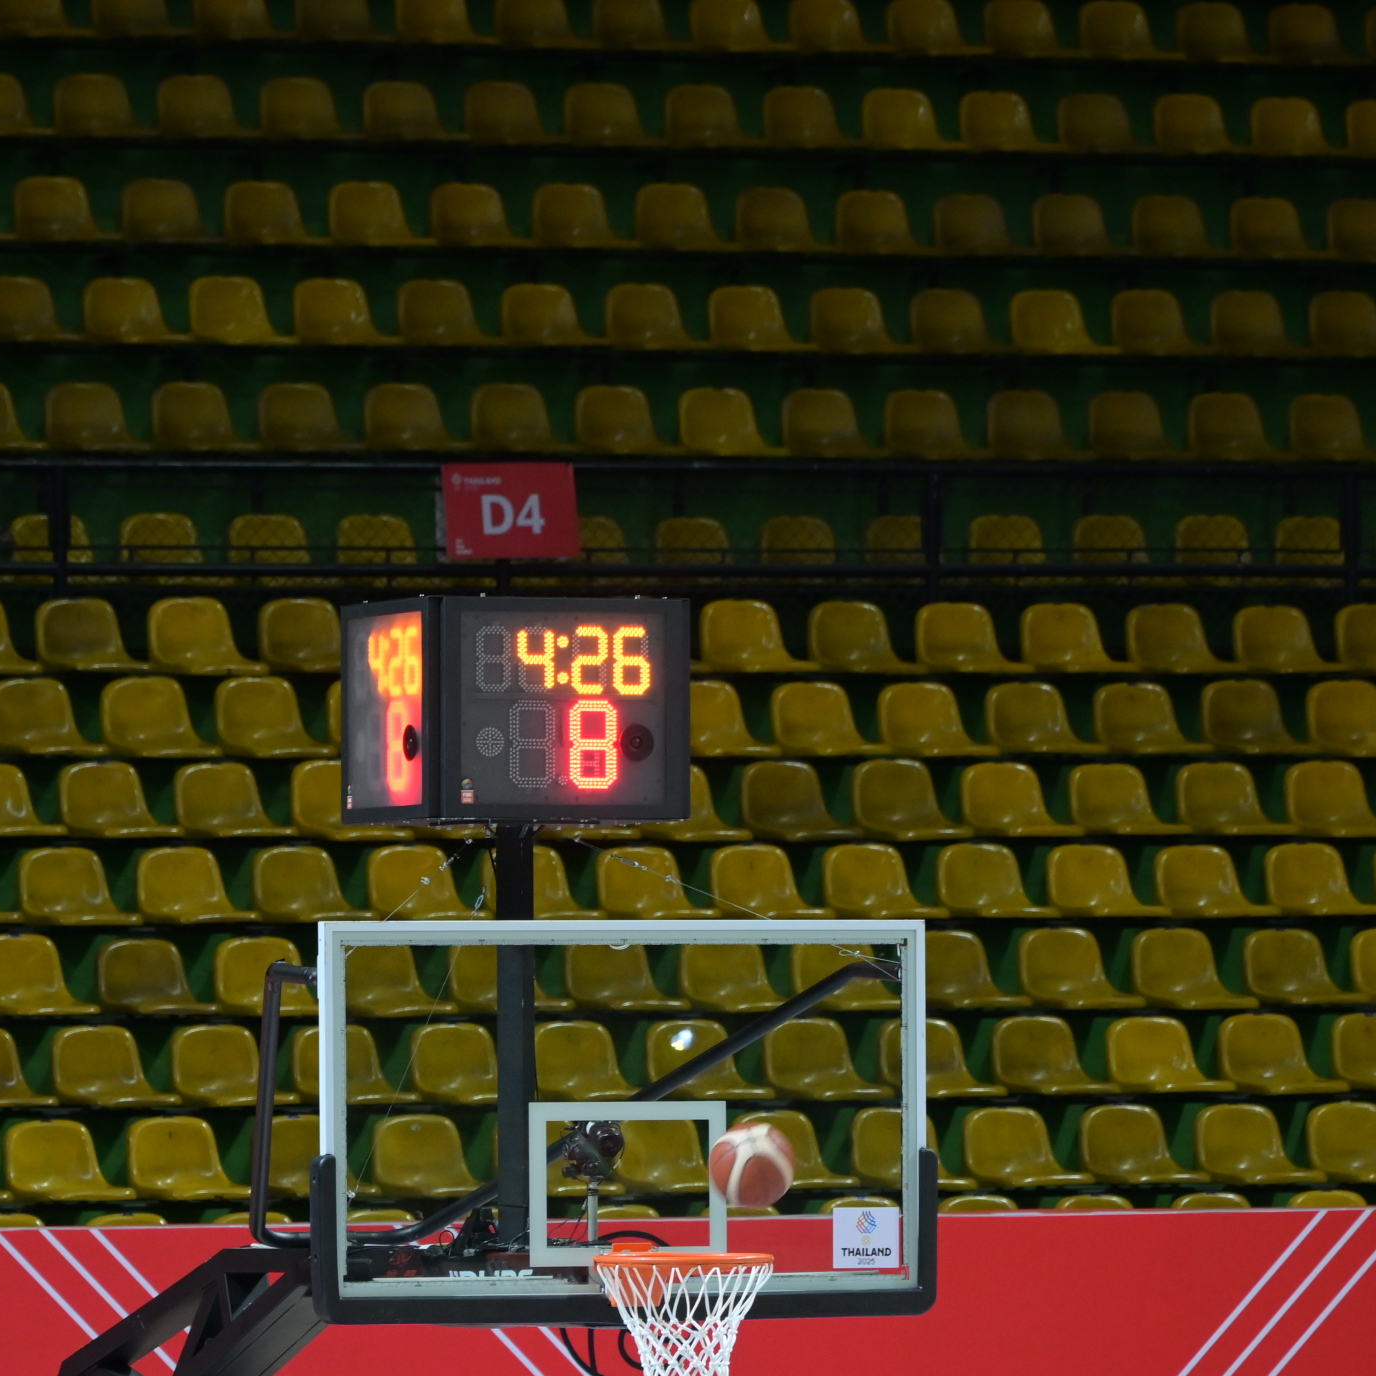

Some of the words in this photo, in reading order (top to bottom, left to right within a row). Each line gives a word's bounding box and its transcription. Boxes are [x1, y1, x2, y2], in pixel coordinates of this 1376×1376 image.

[481, 493, 546, 536] D4
[367, 627, 419, 697] 4:26
[516, 626, 651, 695] 4:26
[568, 700, 618, 789] 8
[841, 1247, 892, 1257] THAILAND
